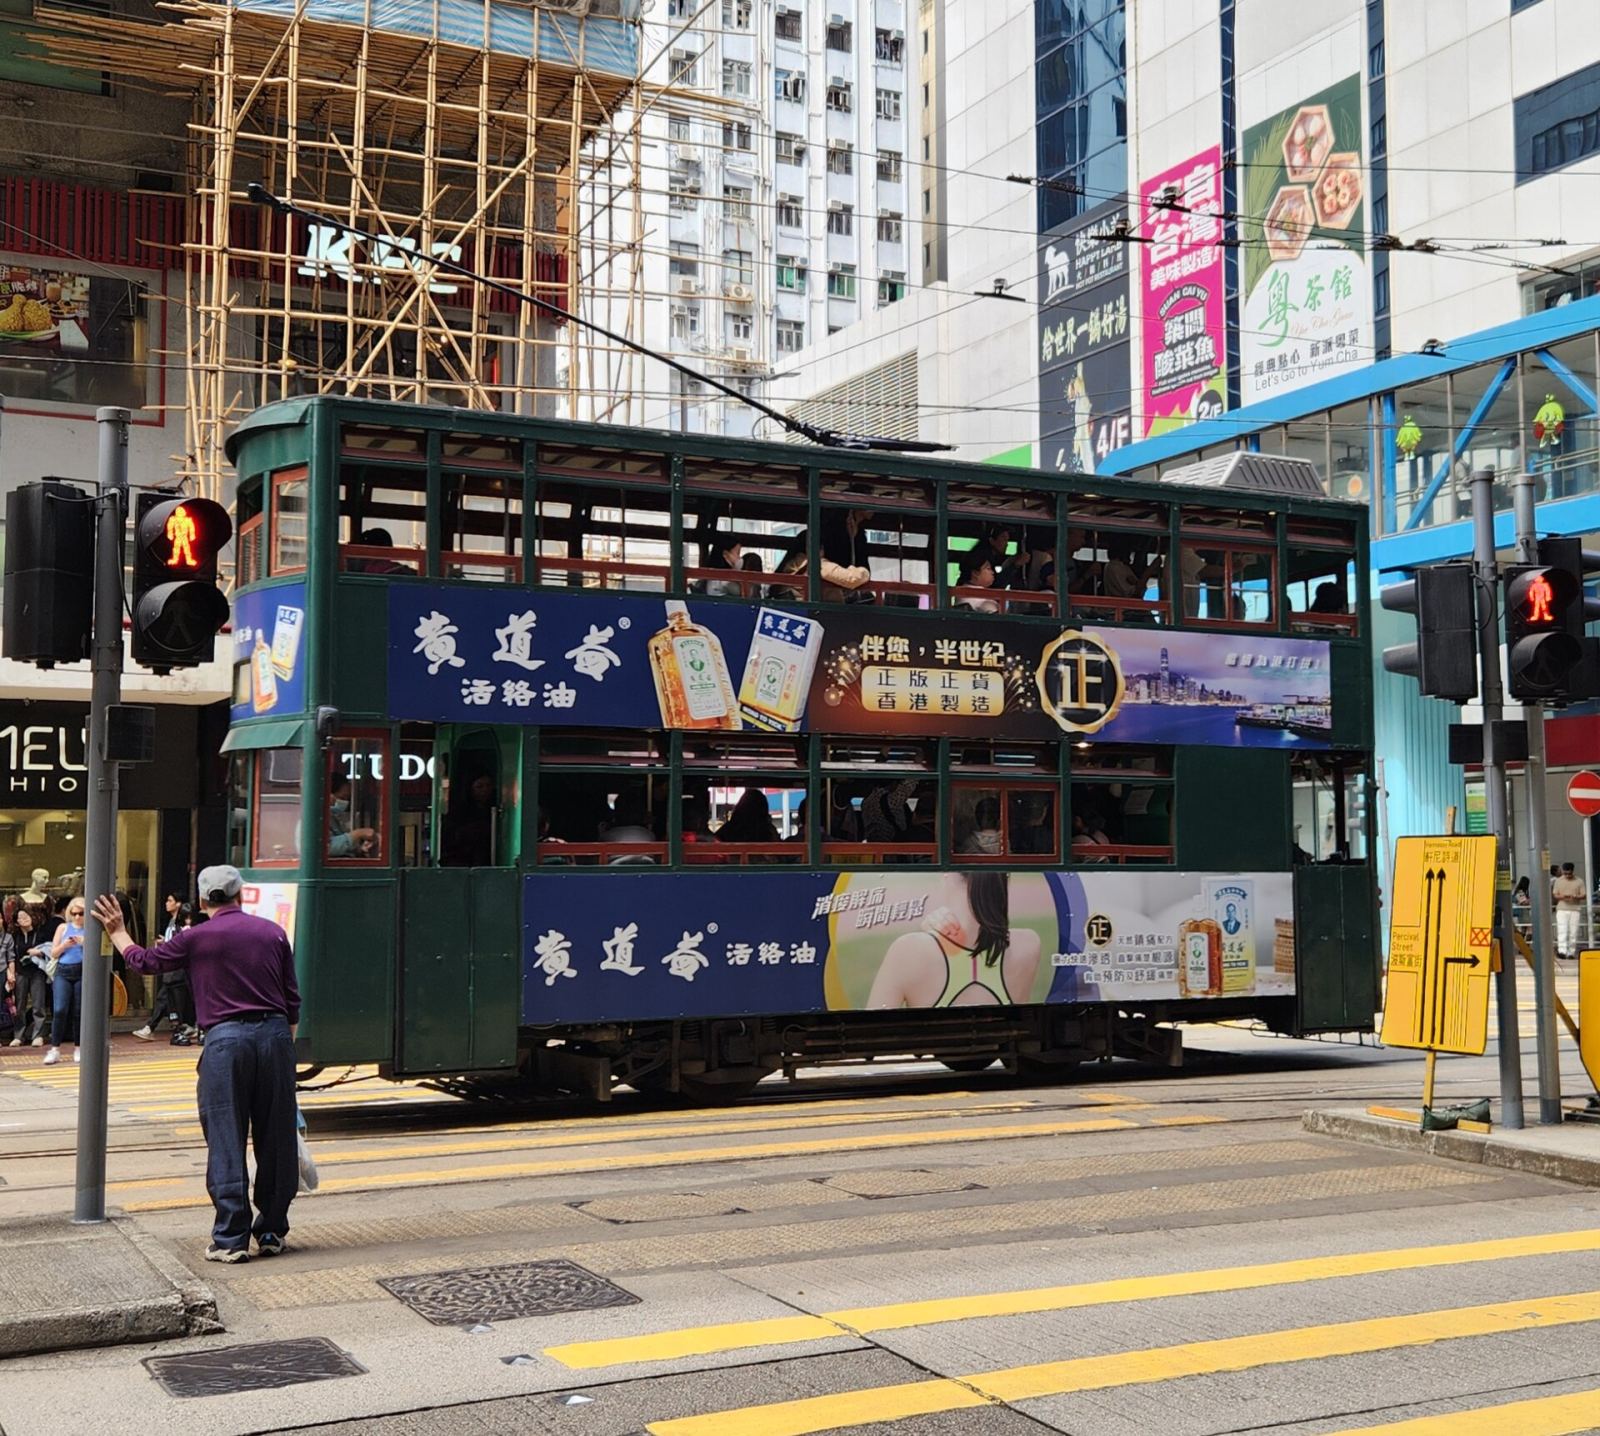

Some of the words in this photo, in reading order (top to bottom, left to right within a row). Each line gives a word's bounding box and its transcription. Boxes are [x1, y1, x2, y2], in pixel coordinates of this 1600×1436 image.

[297, 224, 463, 294] KFC
[1196, 288, 1208, 301] YU
[1154, 335, 1216, 382] 酸菜魚
[1255, 370, 1279, 392] Let's
[1280, 366, 1296, 383] Go
[1310, 353, 1335, 373] Yum
[1335, 347, 1359, 363] Cha
[1198, 401, 1223, 419] 2/F
[1096, 415, 1130, 460] 4/F
[461, 677, 577, 708] 活絡油
[877, 669, 992, 692] 正版正貨
[877, 692, 992, 714] 香港製造
[725, 941, 817, 966] 活絡油
[1391, 943, 1414, 952] Street
